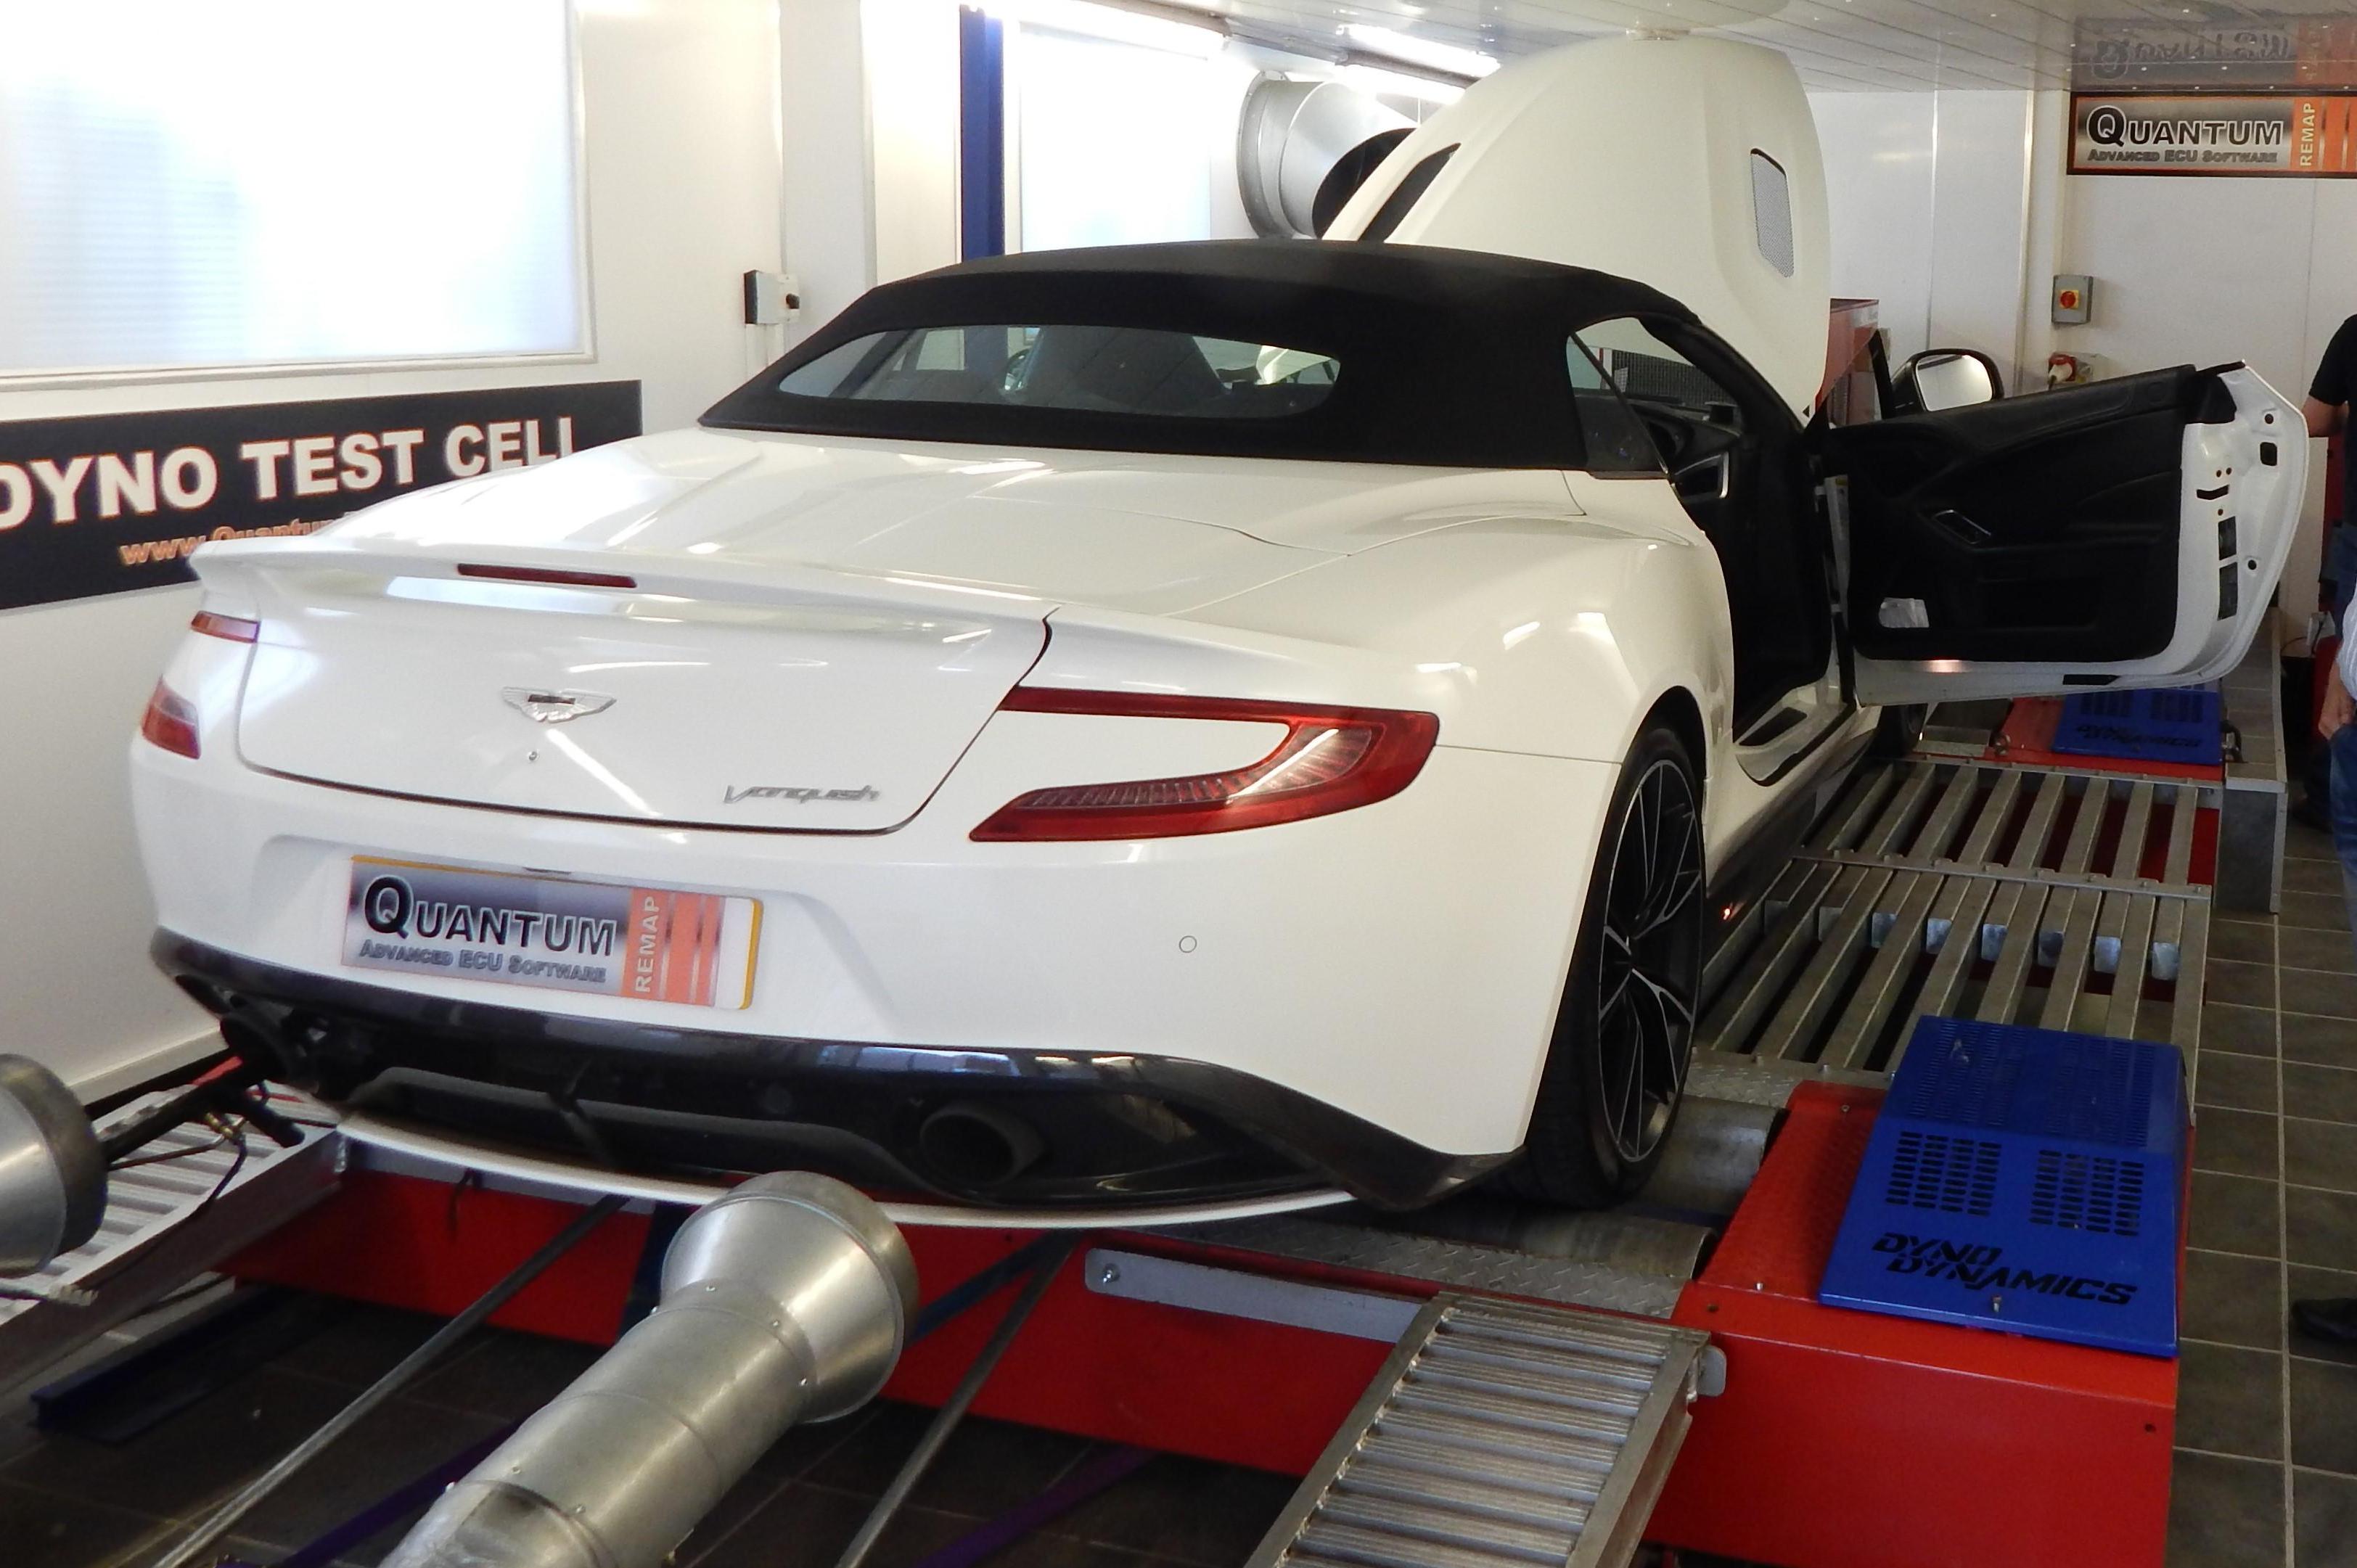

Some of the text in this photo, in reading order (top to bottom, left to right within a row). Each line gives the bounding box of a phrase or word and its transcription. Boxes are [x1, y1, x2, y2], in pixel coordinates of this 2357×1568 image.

[2086, 105, 2284, 147] QUANTUM
[2300, 102, 2316, 166] REMAP
[2087, 149, 2278, 163] ADVANCED ECU SOFTWARE
[0, 446, 218, 530] DYNO
[241, 430, 424, 499] TEST
[364, 875, 617, 957] QUANTUM
[360, 939, 606, 983] ADVANCED ECU SOFTWARE
[634, 895, 664, 994] REMAP
[1872, 1232, 2003, 1266] DYNO
[1886, 1253, 2138, 1305] DYNAMICS
